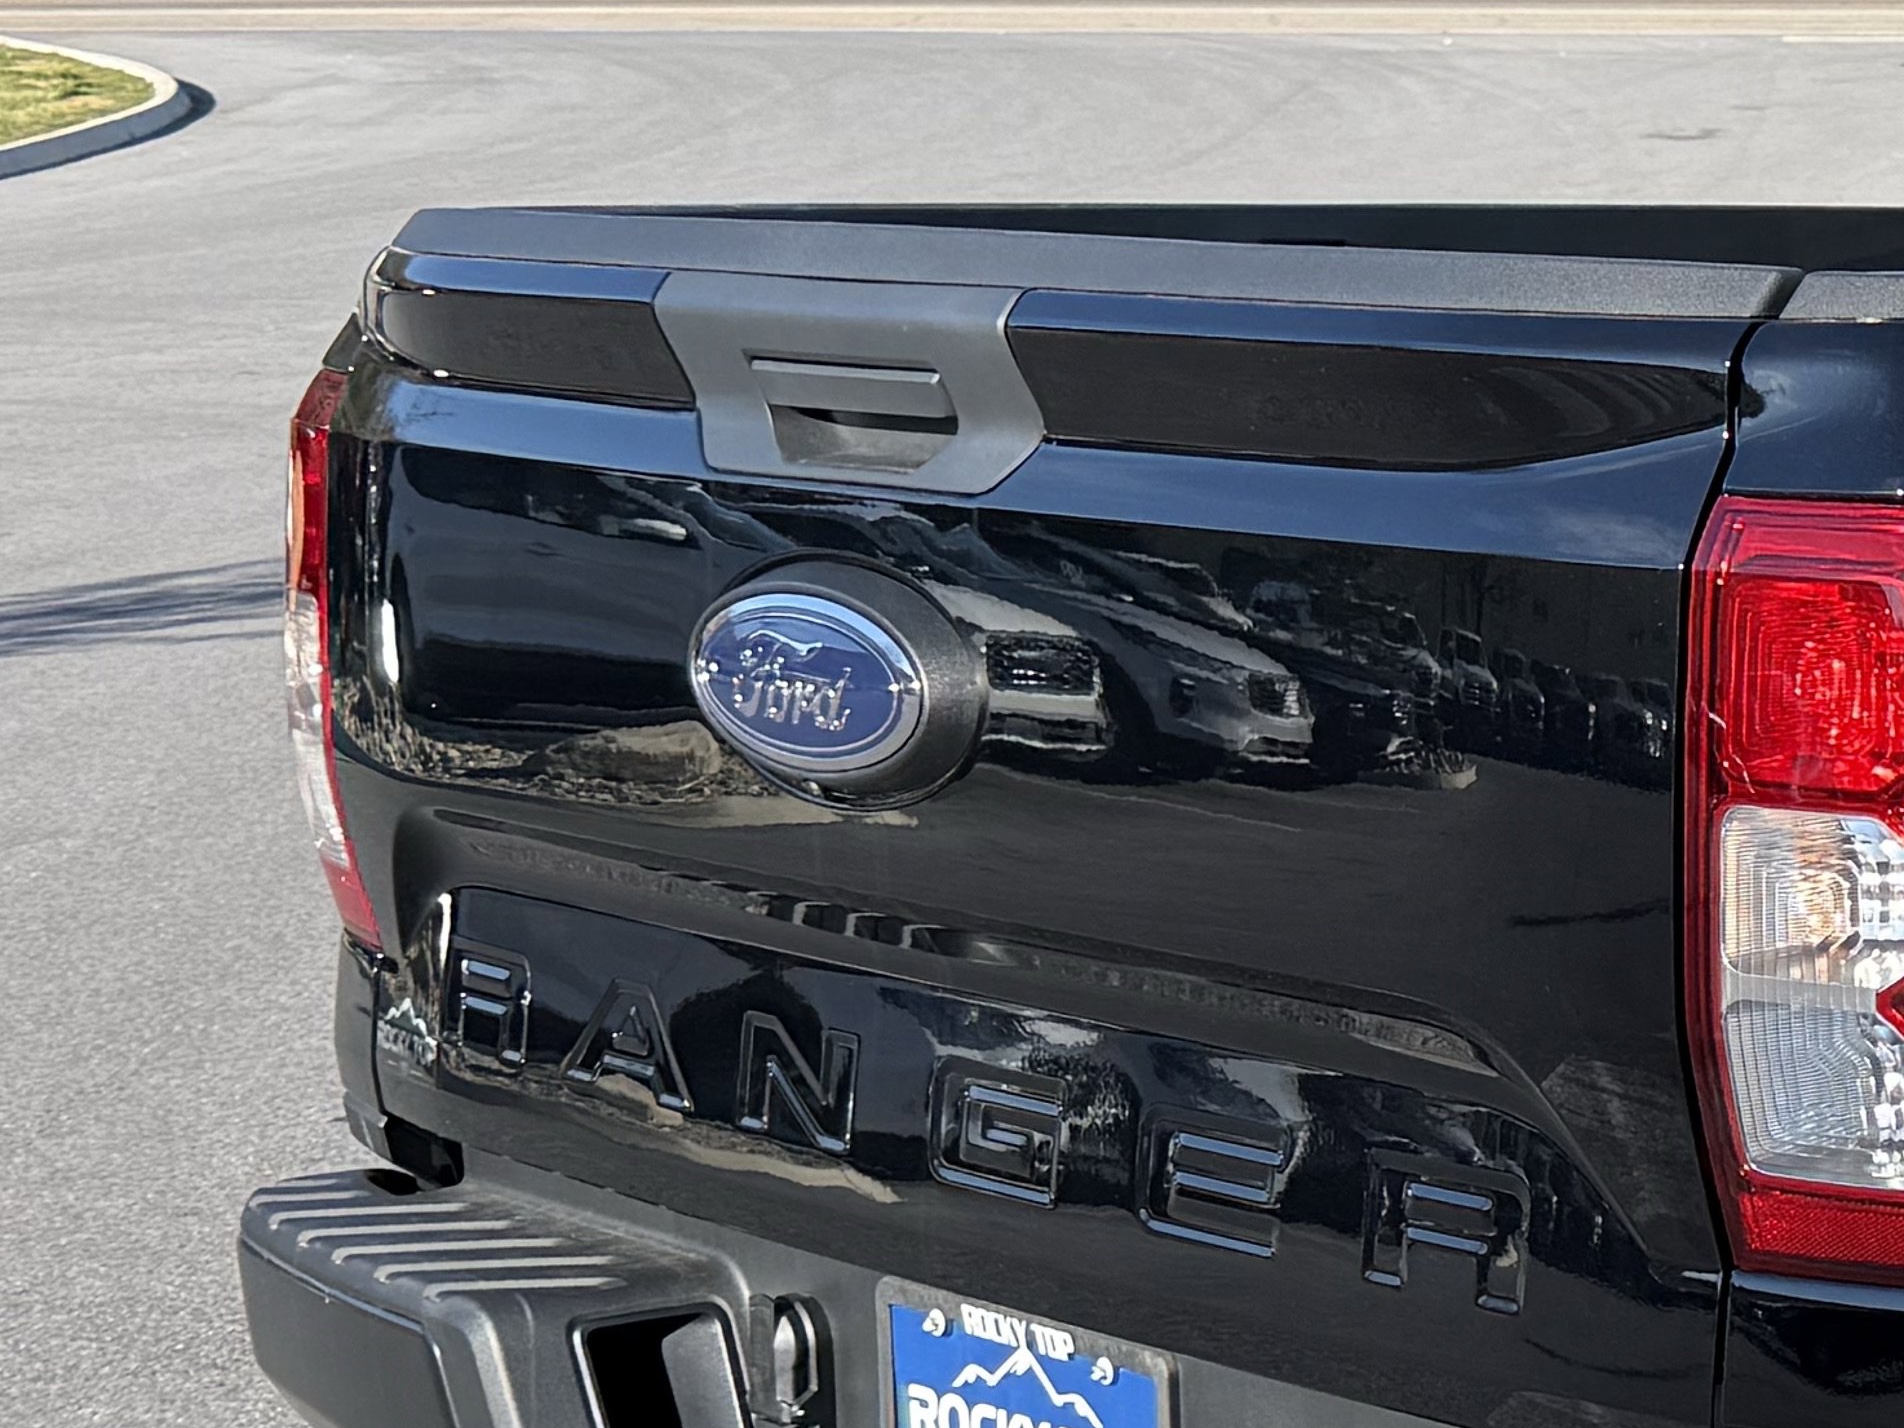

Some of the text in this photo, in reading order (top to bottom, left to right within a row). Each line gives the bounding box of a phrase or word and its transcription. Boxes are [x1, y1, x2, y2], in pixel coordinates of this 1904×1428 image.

[446, 934, 1532, 1316] RANGER
[960, 1303, 1075, 1362] ROCKY TOP
